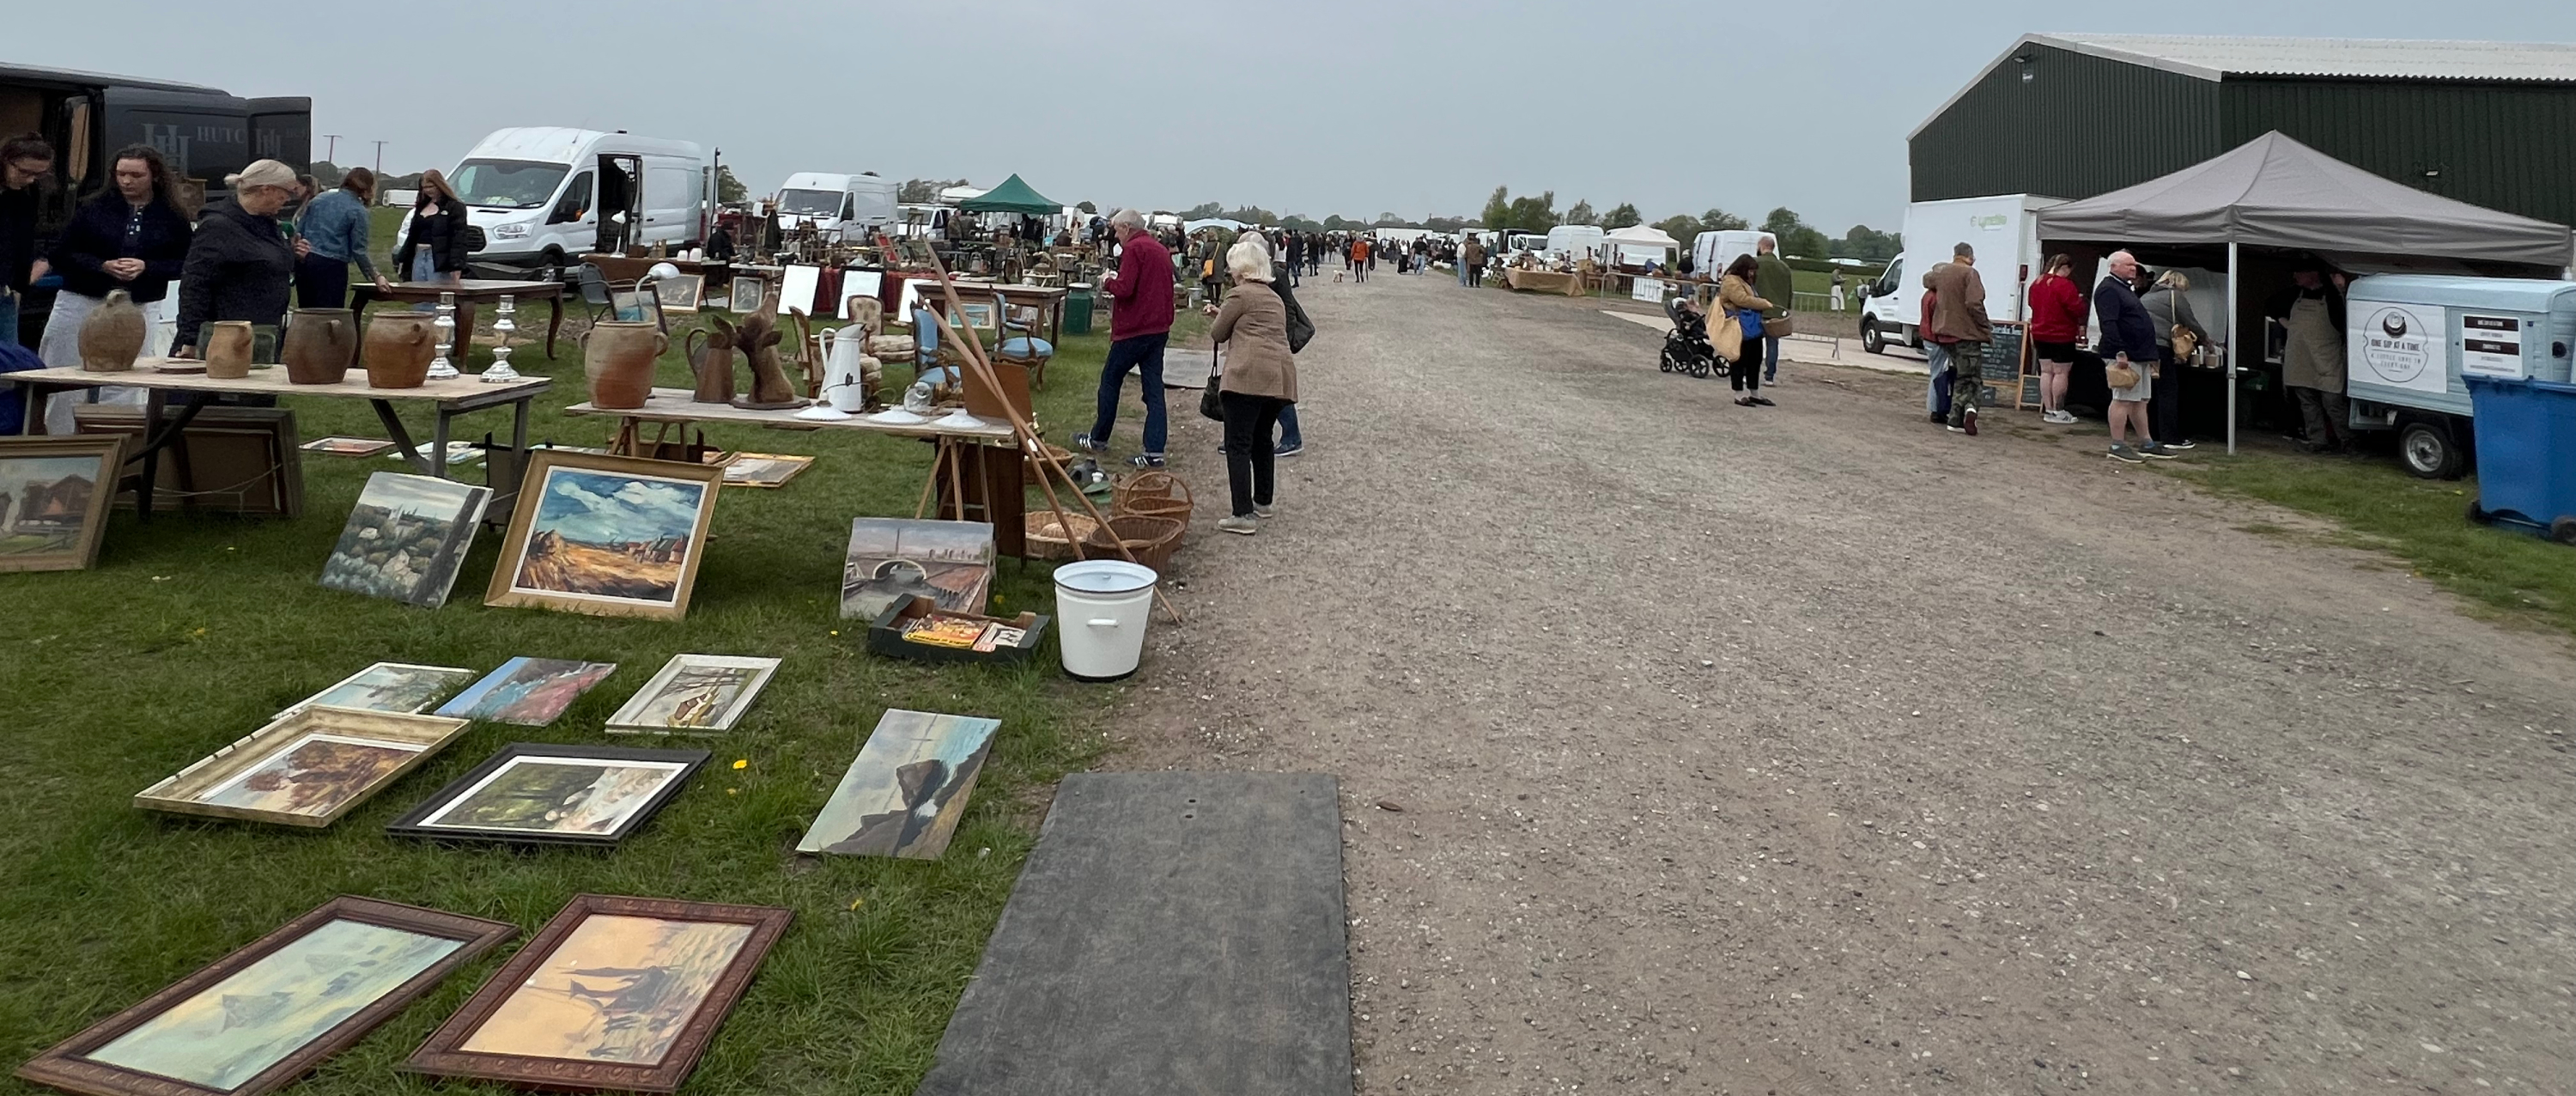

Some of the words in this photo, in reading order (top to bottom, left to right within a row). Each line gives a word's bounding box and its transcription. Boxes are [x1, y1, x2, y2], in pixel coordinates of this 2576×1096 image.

[2371, 338, 2382, 347] ONE
[2383, 339, 2393, 349] SIP
[2393, 340, 2400, 350] AT
[2406, 342, 2421, 352] TIME
